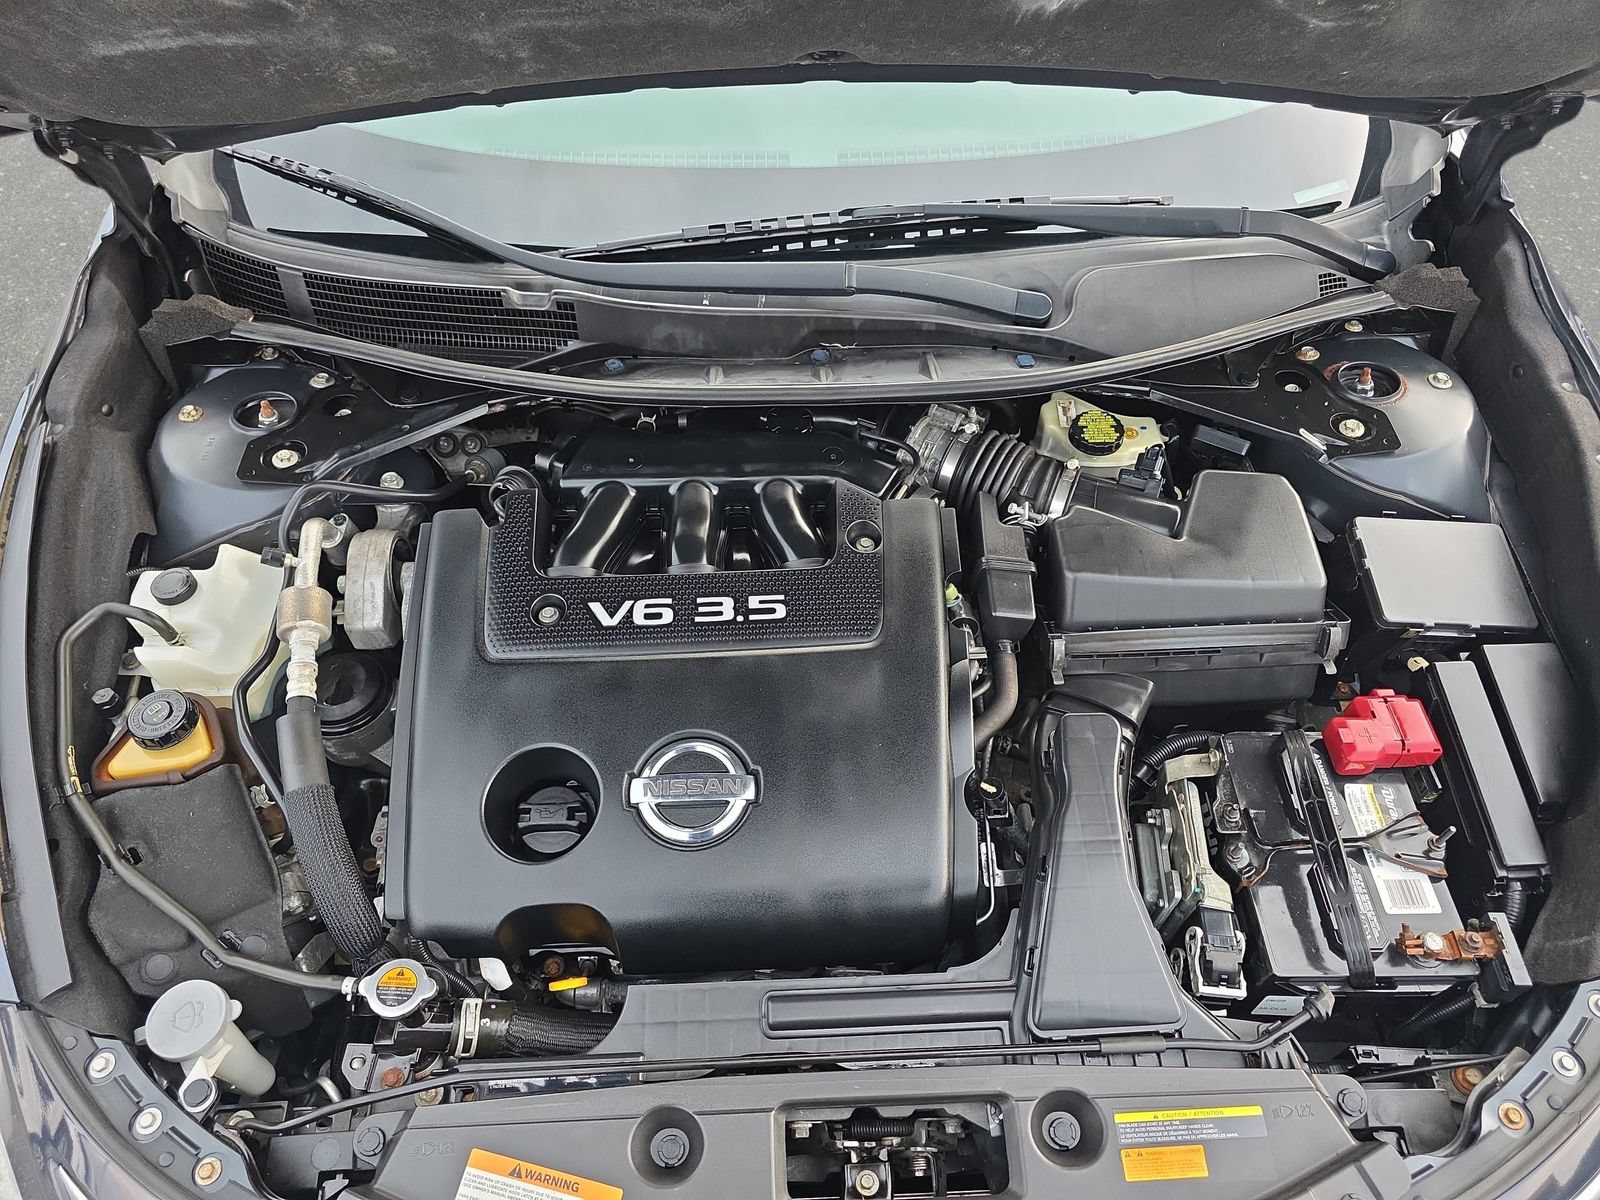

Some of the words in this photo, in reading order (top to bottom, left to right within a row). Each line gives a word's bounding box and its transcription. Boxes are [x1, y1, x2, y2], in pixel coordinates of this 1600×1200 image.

[588, 598, 673, 627] V6
[694, 594, 787, 622] 3.5
[643, 778, 741, 797] NISSAN
[1316, 760, 1329, 785] DANGER
[1328, 791, 1339, 816] POISON
[525, 1168, 580, 1192] WARNING
